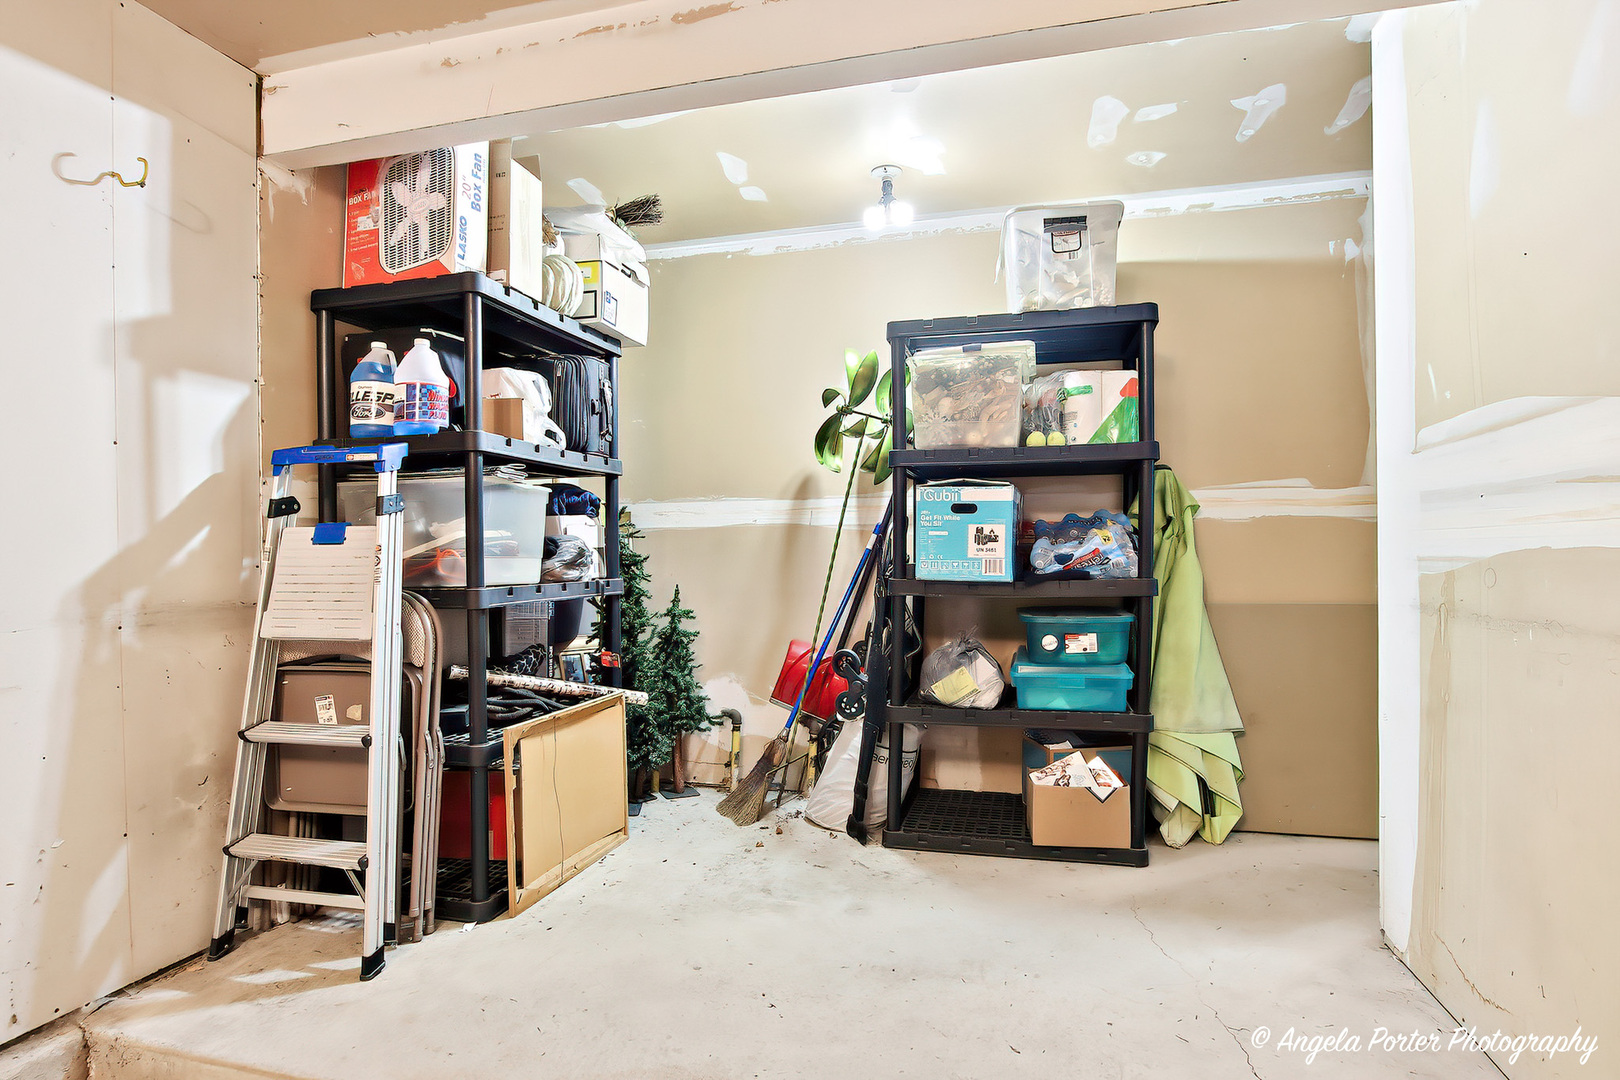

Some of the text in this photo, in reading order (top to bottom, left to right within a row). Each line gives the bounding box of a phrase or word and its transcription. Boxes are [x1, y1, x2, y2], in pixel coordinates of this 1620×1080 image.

[471, 153, 482, 213] Box Fan
[349, 194, 363, 206] BOX
[457, 215, 468, 261] LASKO
[923, 489, 959, 502] Cubii
